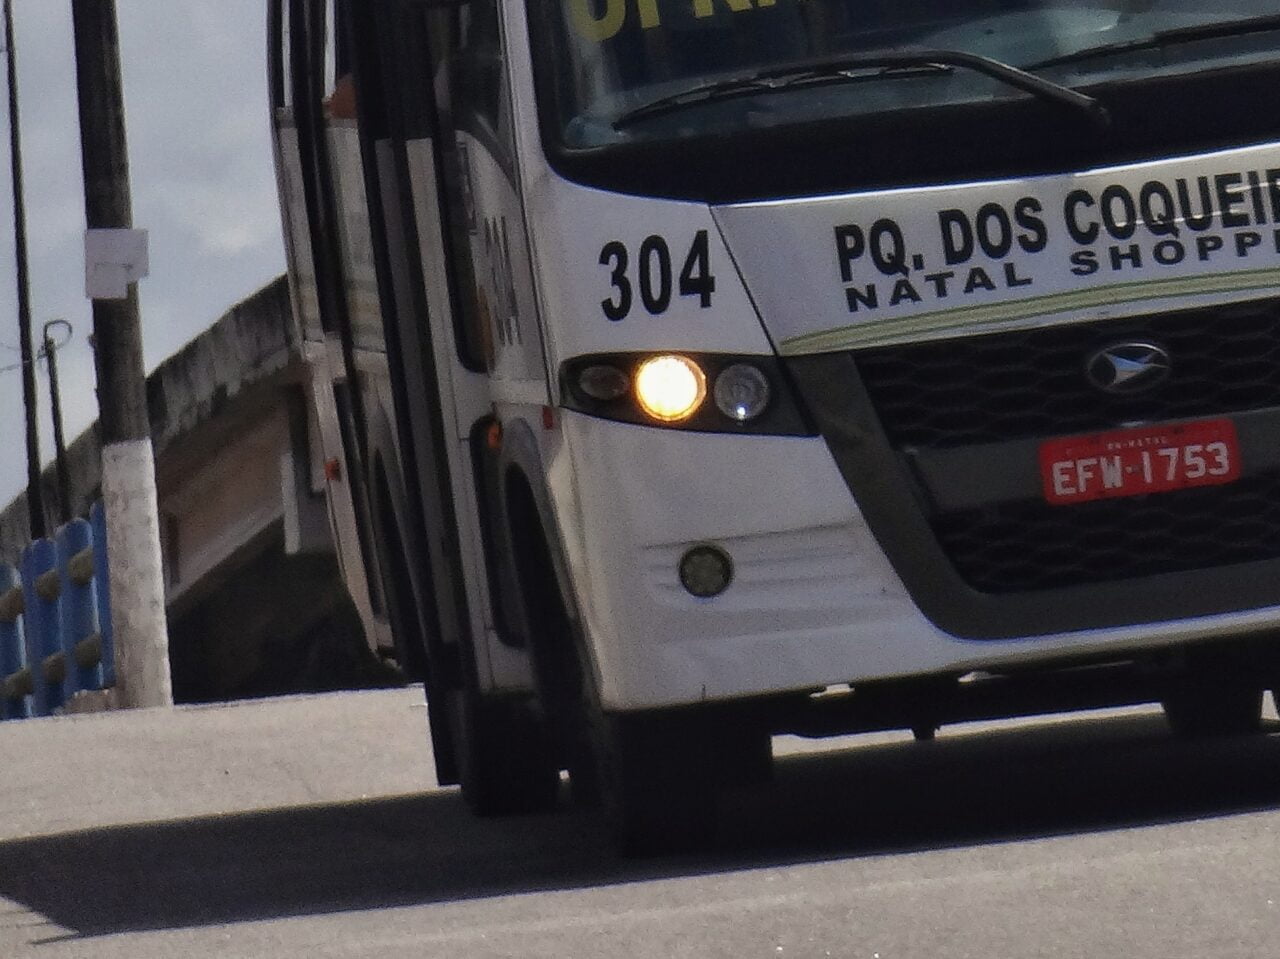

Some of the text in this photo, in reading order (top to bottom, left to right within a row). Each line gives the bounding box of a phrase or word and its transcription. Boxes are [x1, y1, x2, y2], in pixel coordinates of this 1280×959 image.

[599, 229, 716, 321] 304
[835, 218, 923, 282] PQ.
[938, 196, 1049, 266] DOS
[845, 261, 1033, 313] NATAL
